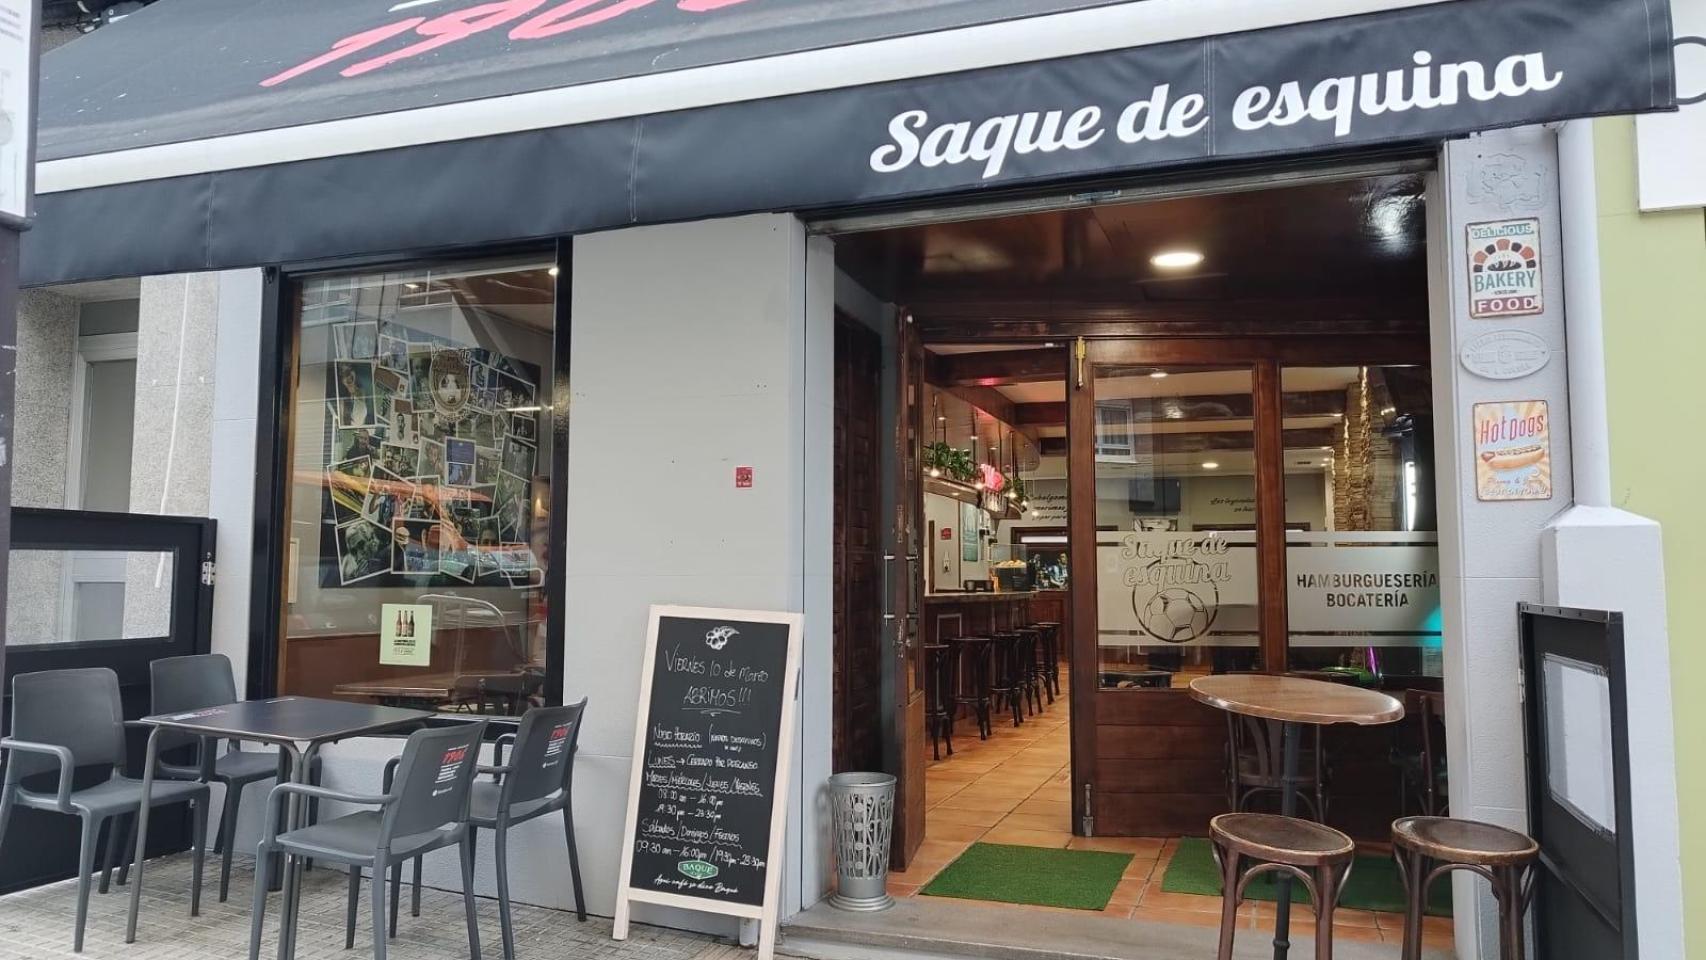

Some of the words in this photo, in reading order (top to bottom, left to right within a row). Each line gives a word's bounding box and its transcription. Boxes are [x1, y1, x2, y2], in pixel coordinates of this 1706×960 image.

[870, 110, 1104, 179] Saque
[1116, 84, 1209, 143] de
[1232, 50, 1563, 137] esquina
[1472, 224, 1534, 238] DELICIOUS
[1474, 271, 1535, 292] BAKERY
[1478, 298, 1534, 312] FOOD
[1480, 416, 1506, 444] Hot
[1510, 415, 1543, 440] Dogs
[1121, 534, 1196, 564] Saque
[1201, 537, 1230, 555] de
[1123, 557, 1232, 592] esquina
[1297, 571, 1436, 588] HAMBURGUESERÍA
[1326, 590, 1408, 607] BOCATERÍA
[709, 661, 721, 677] 10
[724, 661, 736, 678] de
